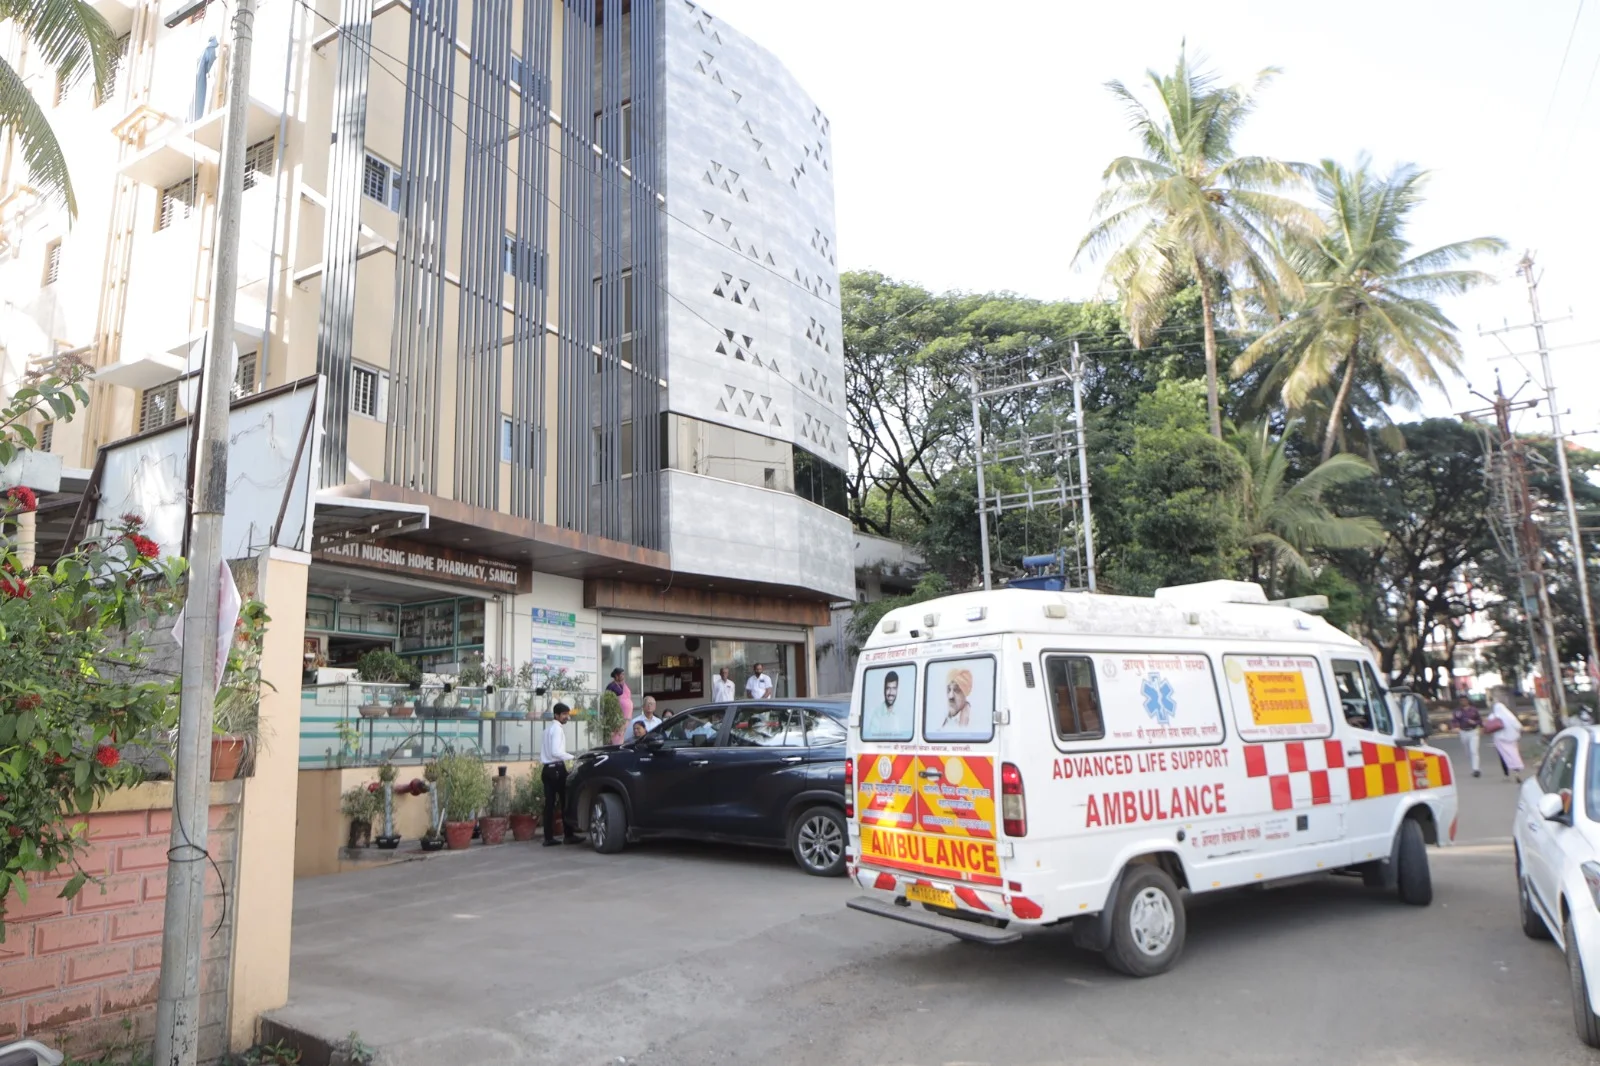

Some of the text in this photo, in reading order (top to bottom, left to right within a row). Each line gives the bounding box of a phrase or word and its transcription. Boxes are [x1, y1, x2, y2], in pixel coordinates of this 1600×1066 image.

[324, 543, 359, 558] ALATI
[361, 545, 405, 565] NURSING
[408, 553, 434, 571] HOME
[437, 559, 487, 582] PHARMACY,
[489, 568, 518, 585] SANGLI
[1052, 748, 1229, 780] ADVANCED LIFE SUPPORT
[1085, 782, 1228, 828] AMBULANCE
[871, 829, 997, 874] AMBULANCE
